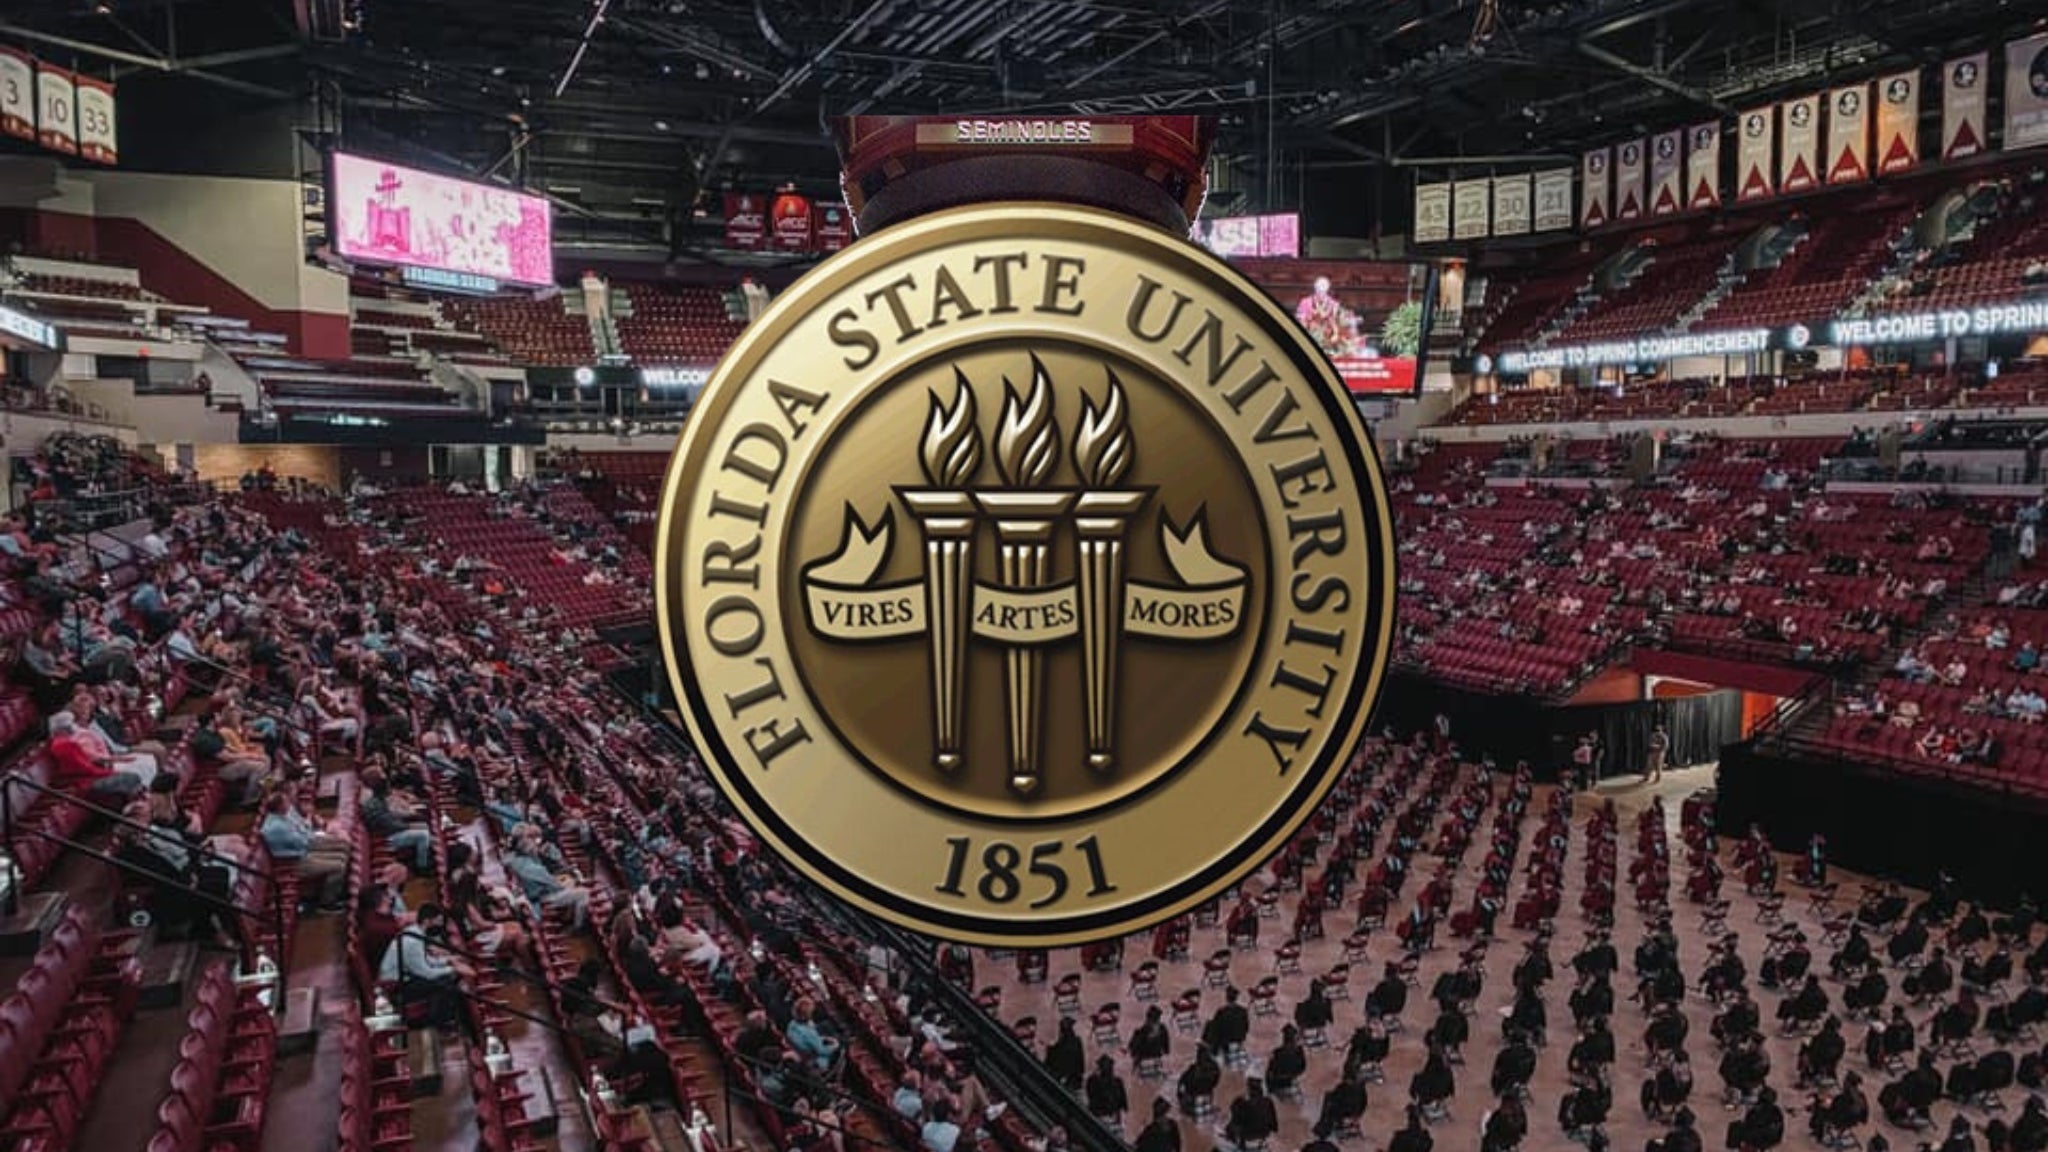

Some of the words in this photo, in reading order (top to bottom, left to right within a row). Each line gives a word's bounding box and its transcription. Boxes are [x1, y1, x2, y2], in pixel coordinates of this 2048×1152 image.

[6, 79, 19, 105] 3
[47, 97, 68, 124] 10
[84, 107, 110, 135] 33
[957, 120, 1092, 142] SEMINOLES
[1420, 203, 1446, 223] 43
[1458, 200, 1483, 220] 22
[1500, 197, 1525, 216] 30
[1834, 311, 1936, 344] WELCOME
[1941, 309, 1969, 333] TO
[1504, 349, 1565, 372] WELCOME
[1565, 346, 1585, 365] TO
[1638, 330, 1769, 357] COMMENCEMENT
